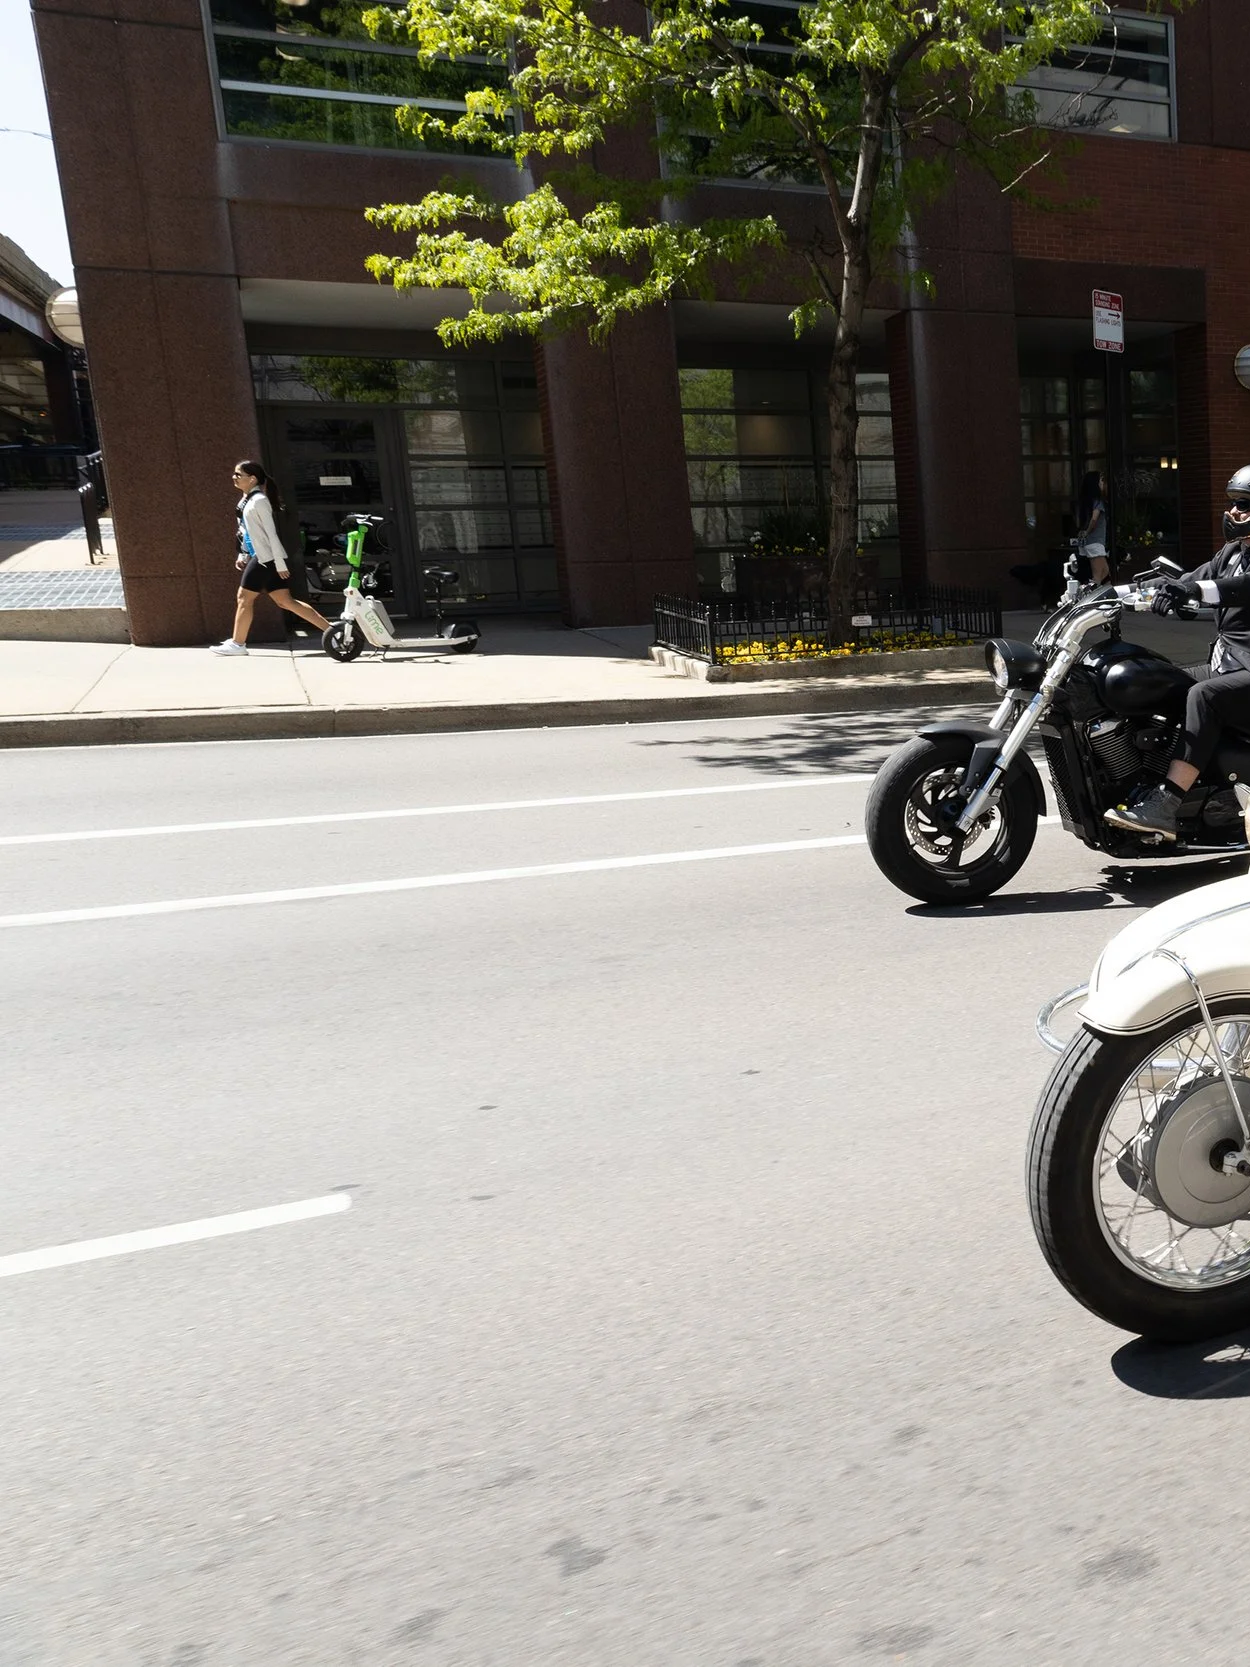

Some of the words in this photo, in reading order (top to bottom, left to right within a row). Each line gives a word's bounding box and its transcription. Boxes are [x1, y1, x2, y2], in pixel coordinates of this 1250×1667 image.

[1095, 299, 1111, 308] STANDING
[1111, 303, 1121, 311] ZONE
[1096, 317, 1110, 325] FLASHING
[1096, 340, 1107, 348] TOW
[1108, 341, 1122, 351] ZONE
